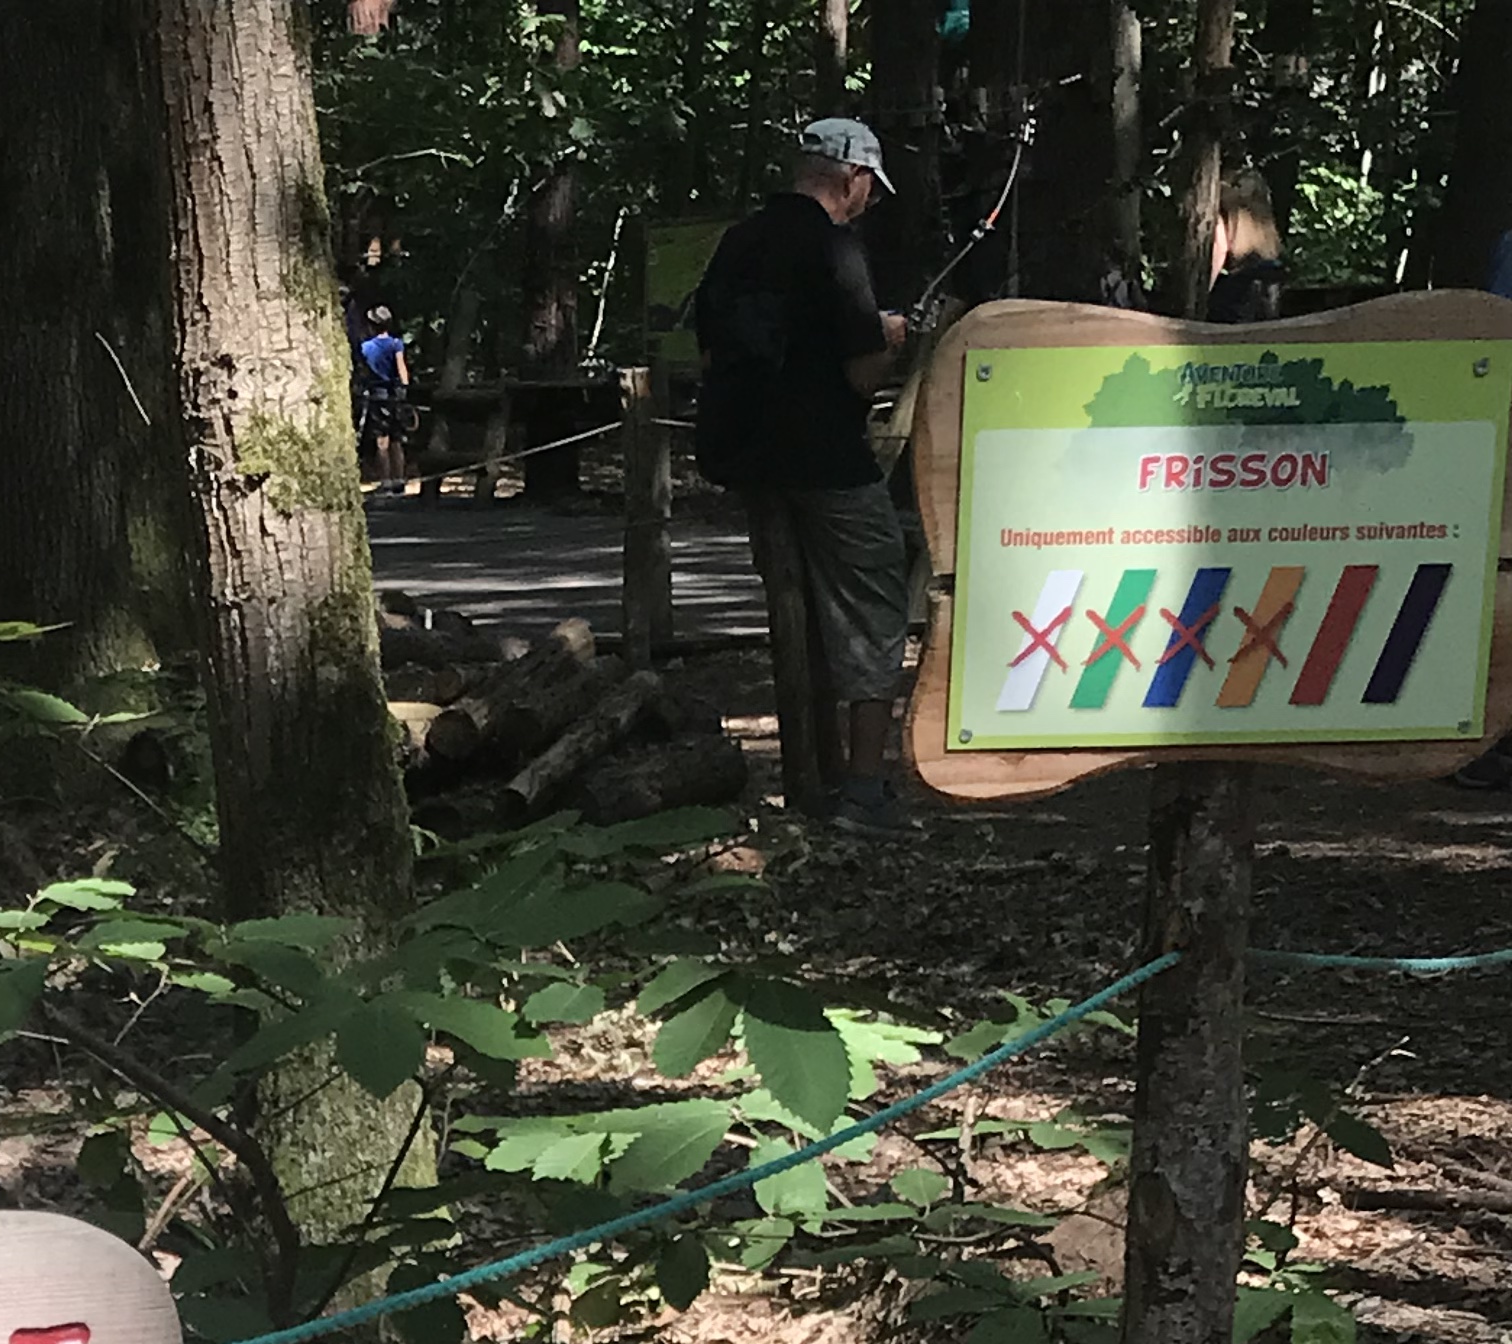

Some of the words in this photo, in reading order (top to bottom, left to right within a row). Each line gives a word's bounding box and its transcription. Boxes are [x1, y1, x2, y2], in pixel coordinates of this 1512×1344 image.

[1000, 527, 1114, 550] Uniquement
[1120, 524, 1223, 544] accessible
[1227, 526, 1262, 543] aux
[1268, 523, 1350, 542] couleurs
[1355, 521, 1448, 540] suivantes
